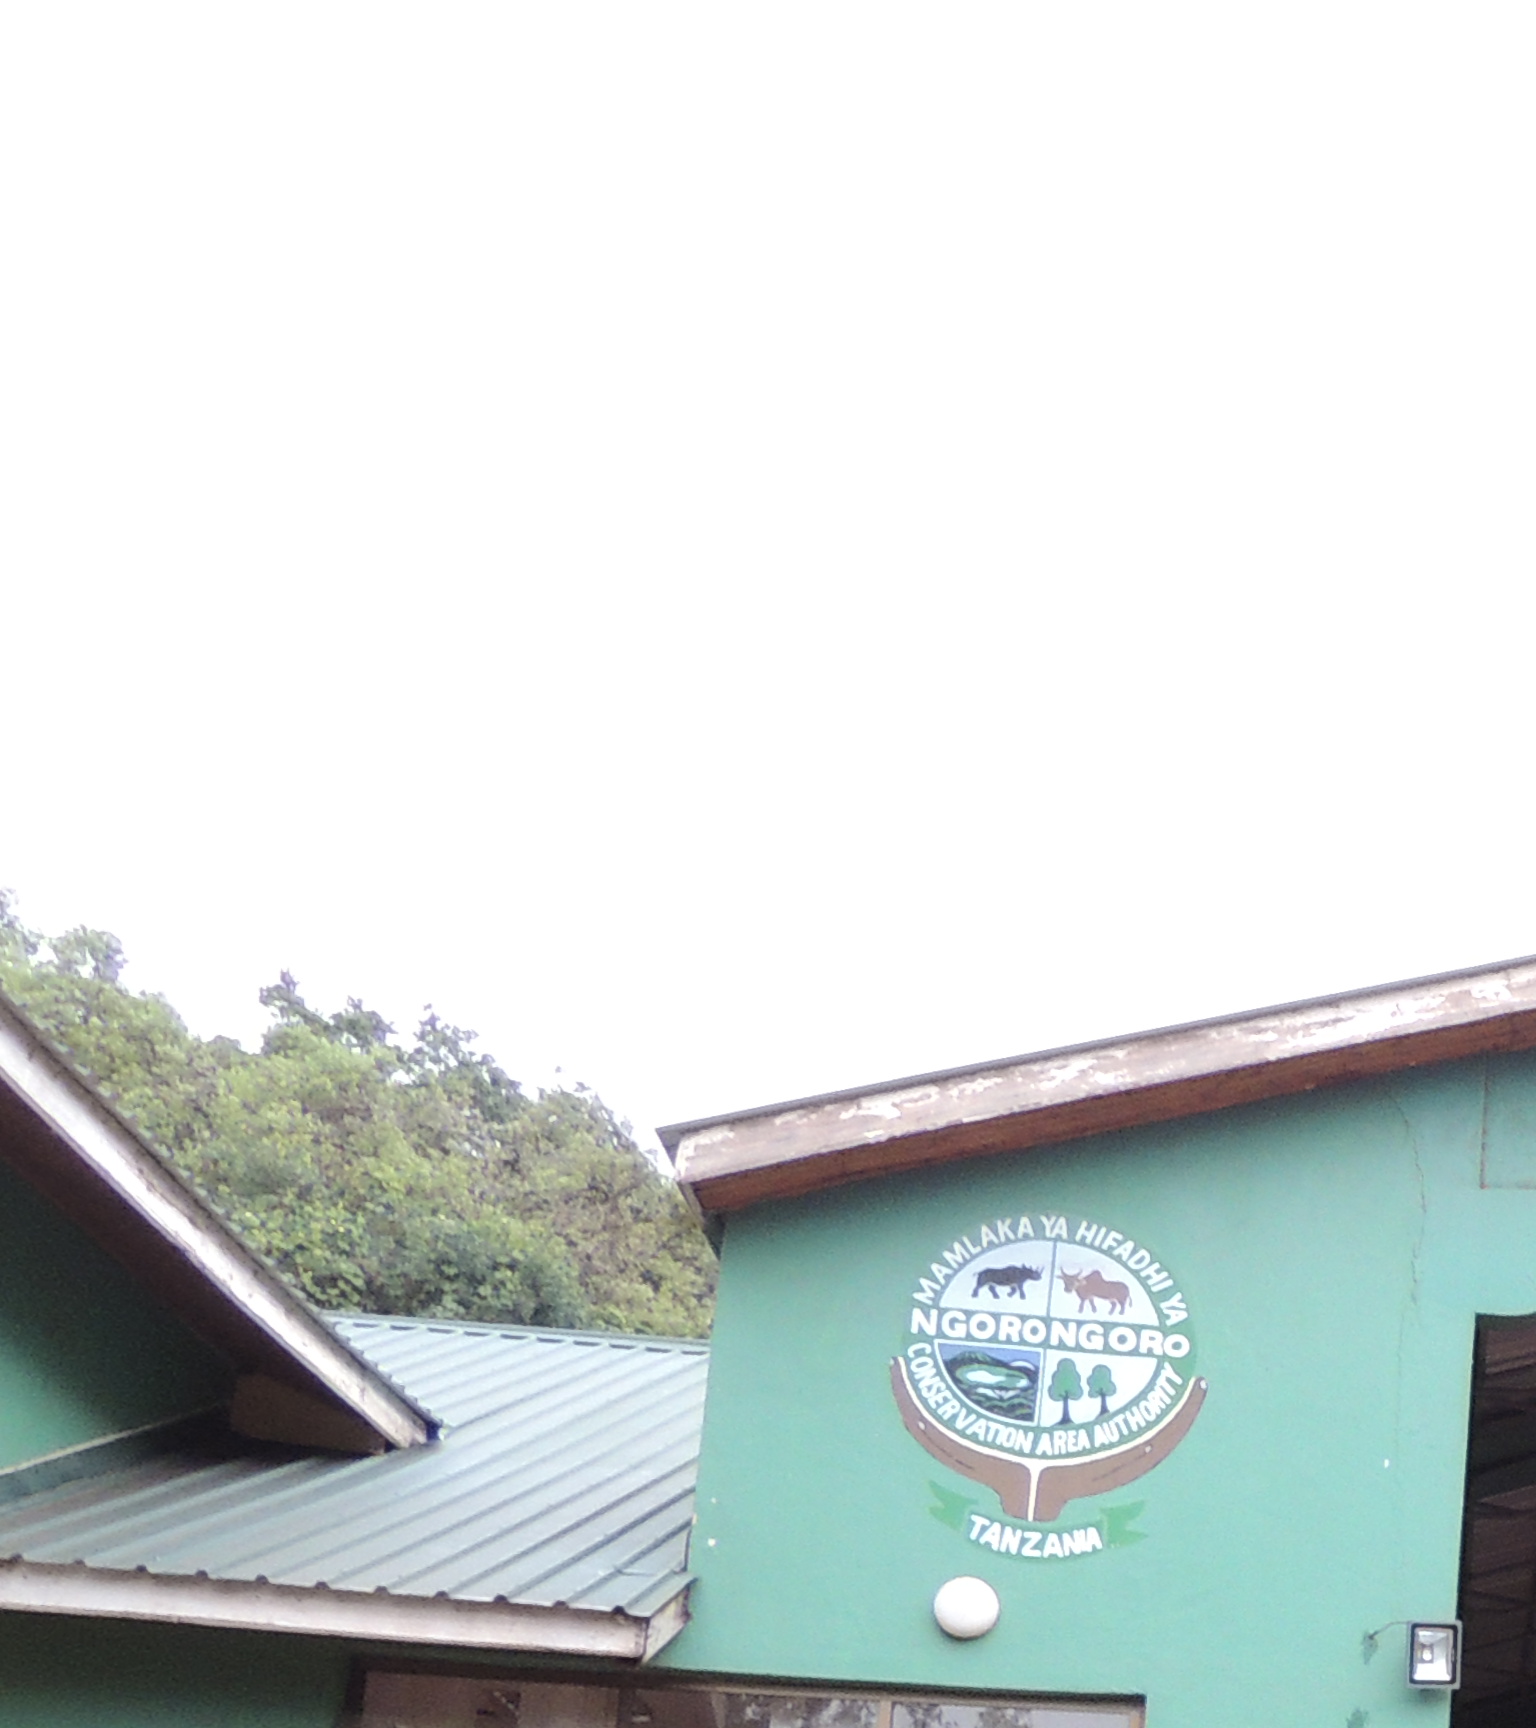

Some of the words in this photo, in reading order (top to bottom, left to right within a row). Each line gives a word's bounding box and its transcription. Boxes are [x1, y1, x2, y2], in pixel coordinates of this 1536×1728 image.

[912, 1216, 1035, 1306] MAMLAKA
[1040, 1215, 1068, 1239] YA
[1075, 1220, 1174, 1293] HIFADHI
[1160, 1291, 1188, 1326] YA
[910, 1307, 1191, 1358] NGORONGORO
[907, 1342, 1034, 1454] CONSERVATION
[1035, 1428, 1090, 1456] AREA
[1094, 1361, 1184, 1448] AUTHORITY
[969, 1514, 1103, 1558] TANZANIA
